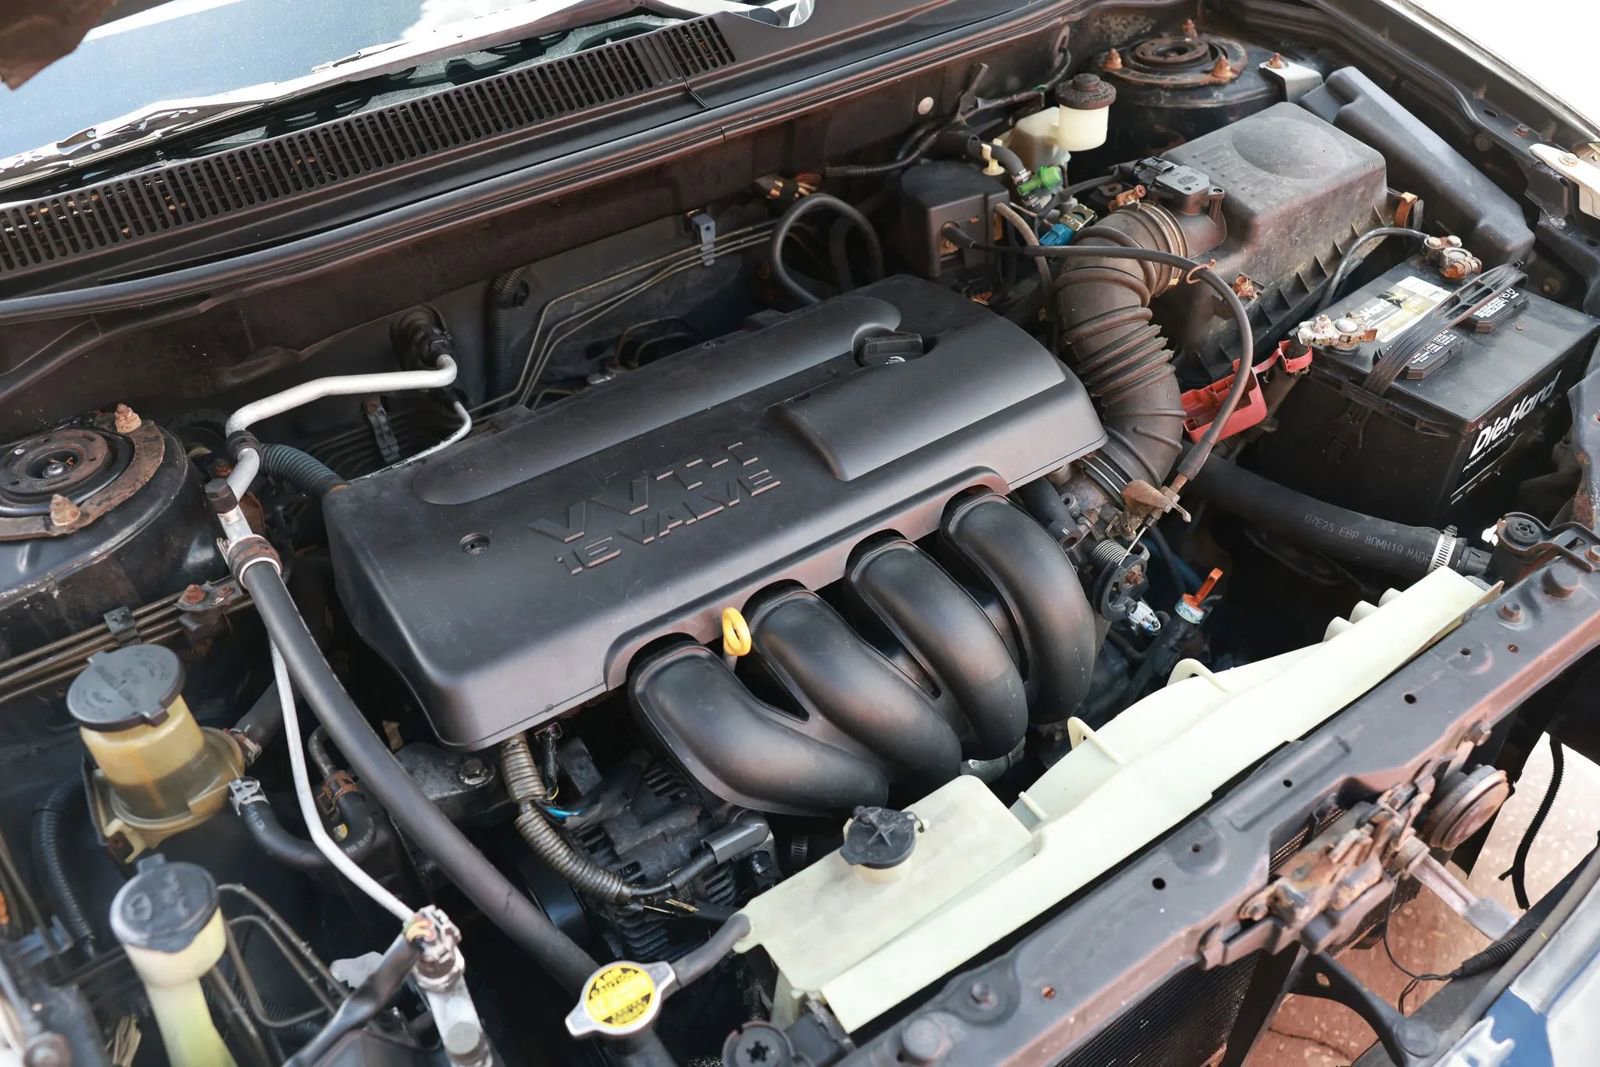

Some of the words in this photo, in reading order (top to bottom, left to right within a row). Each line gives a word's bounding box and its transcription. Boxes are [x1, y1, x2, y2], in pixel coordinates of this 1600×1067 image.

[1468, 369, 1562, 460] DieHard
[554, 535, 622, 576] 16
[616, 462, 782, 545] VALVE
